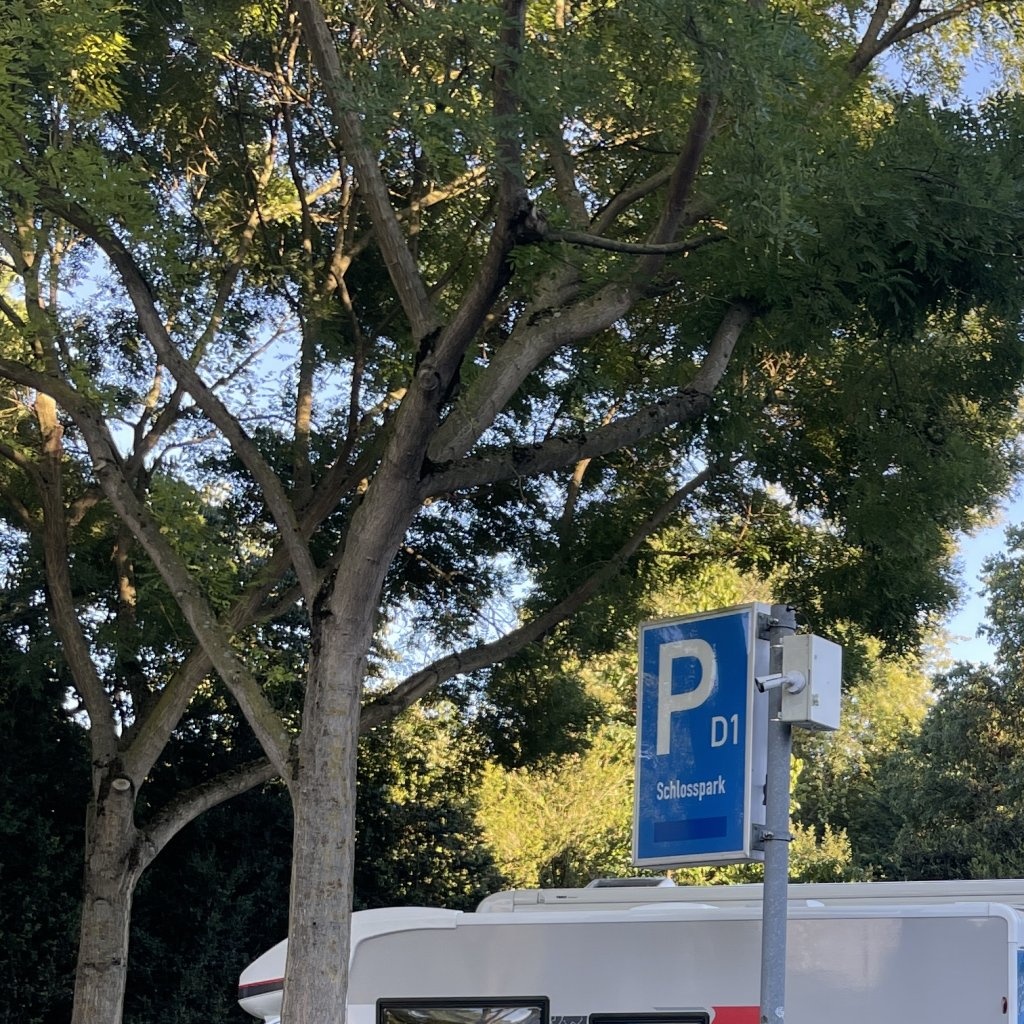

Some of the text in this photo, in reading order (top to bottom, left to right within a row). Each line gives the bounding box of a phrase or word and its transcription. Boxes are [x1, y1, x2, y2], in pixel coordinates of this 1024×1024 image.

[656, 638, 718, 756] P
[711, 713, 739, 748] D1
[656, 775, 726, 802] Schlosspark
